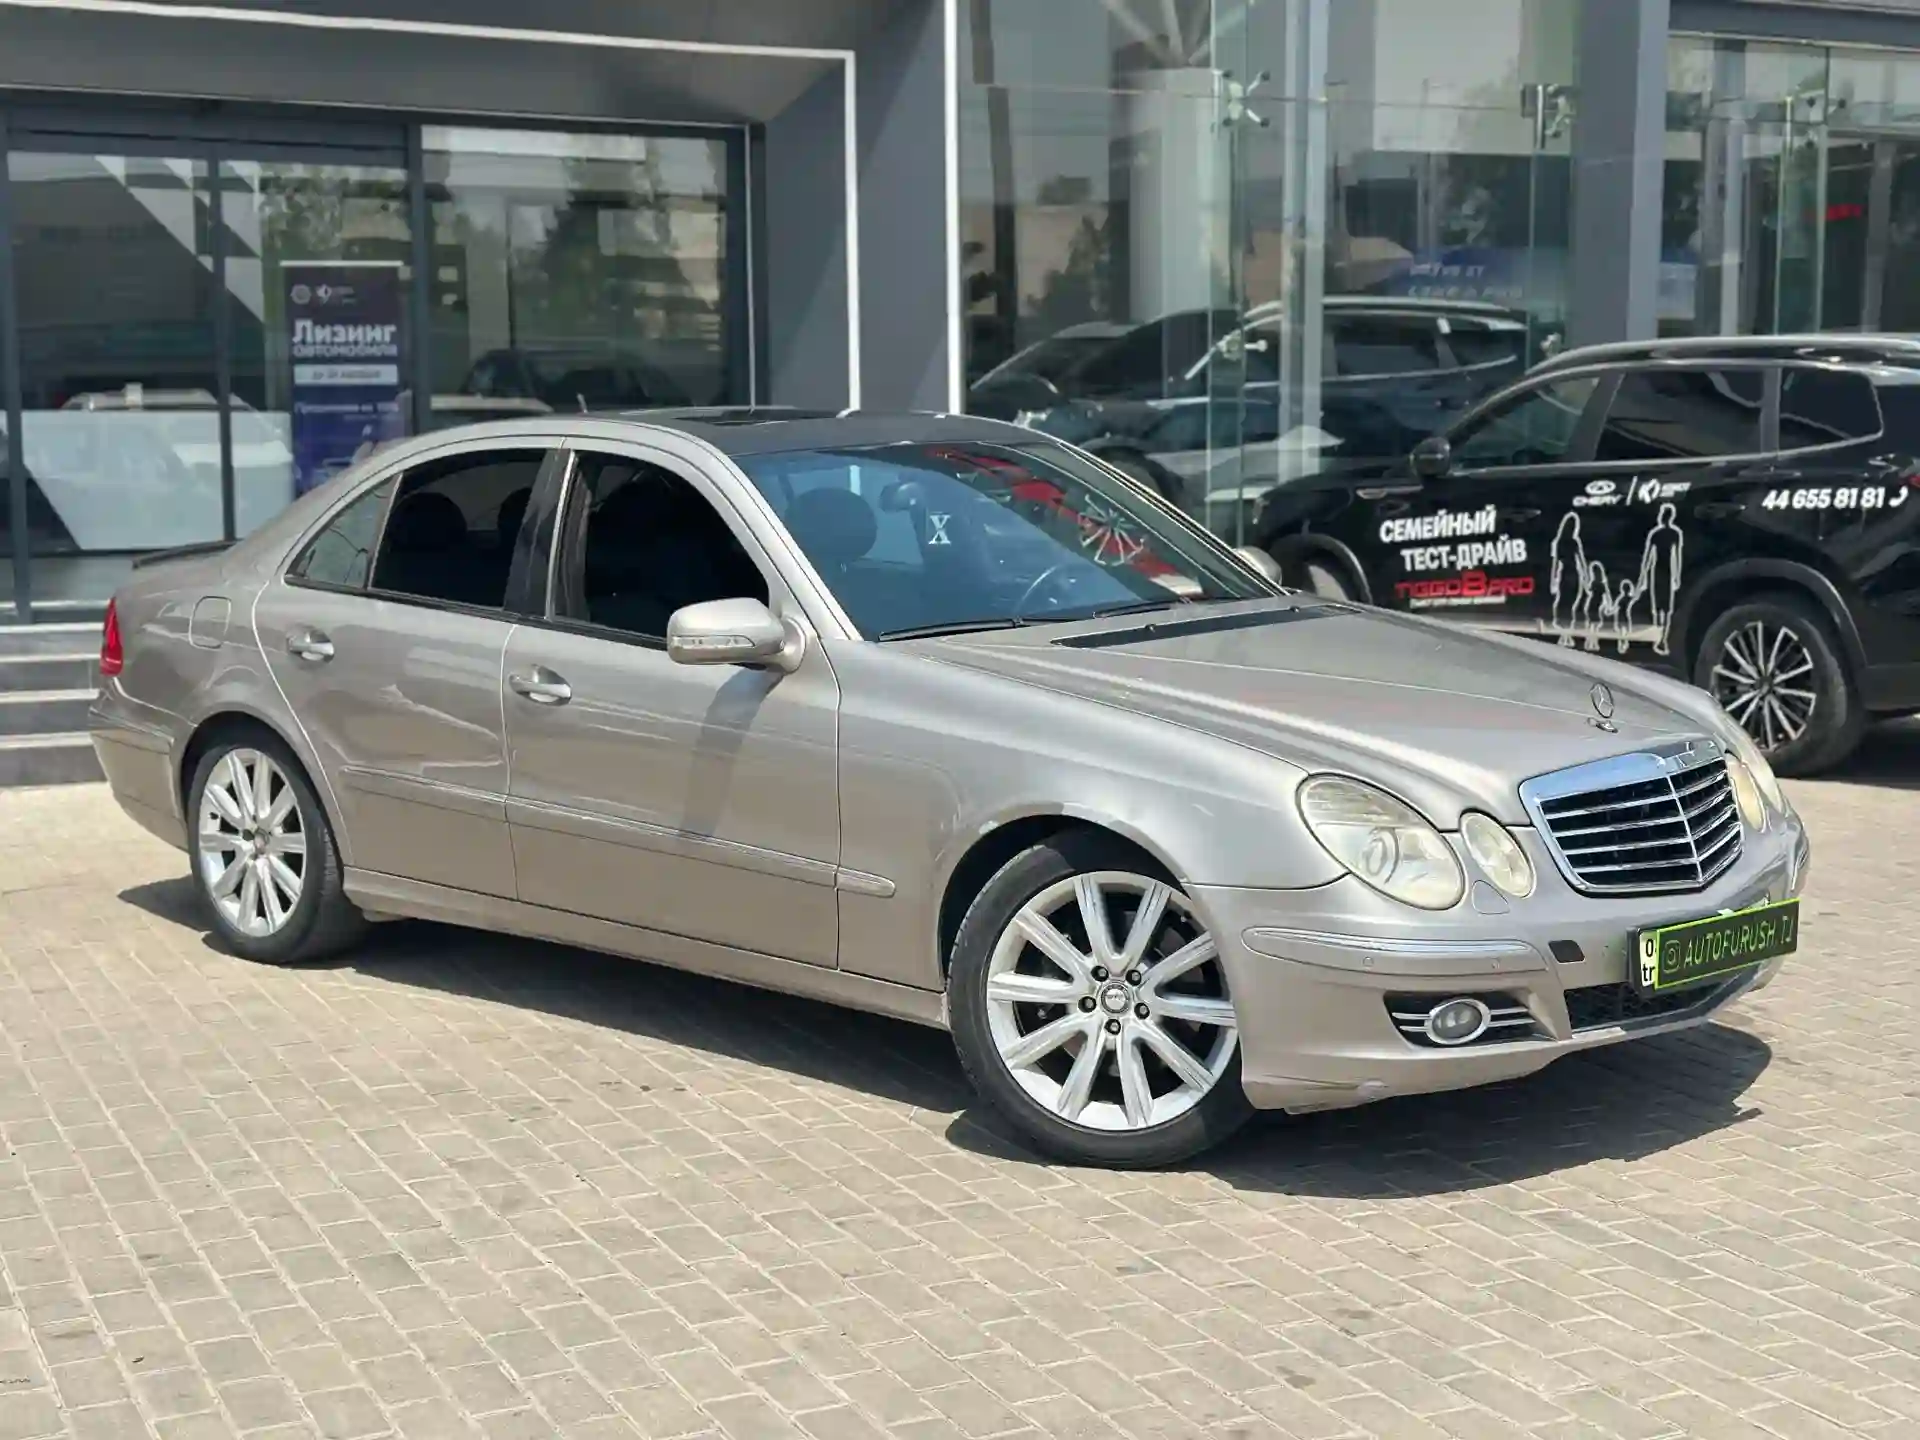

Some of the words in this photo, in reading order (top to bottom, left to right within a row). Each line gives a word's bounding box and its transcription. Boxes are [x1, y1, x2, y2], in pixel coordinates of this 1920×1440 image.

[292, 318, 397, 344] Лизинг
[1761, 489, 1790, 510] 44
[1791, 487, 1832, 509] 655
[1833, 486, 1859, 509] 81
[1860, 486, 1886, 509] 81
[1379, 503, 1497, 543] СЕМЕЙНЫЙ
[1400, 533, 1527, 571] ТЕСТ-ДРАЙВ
